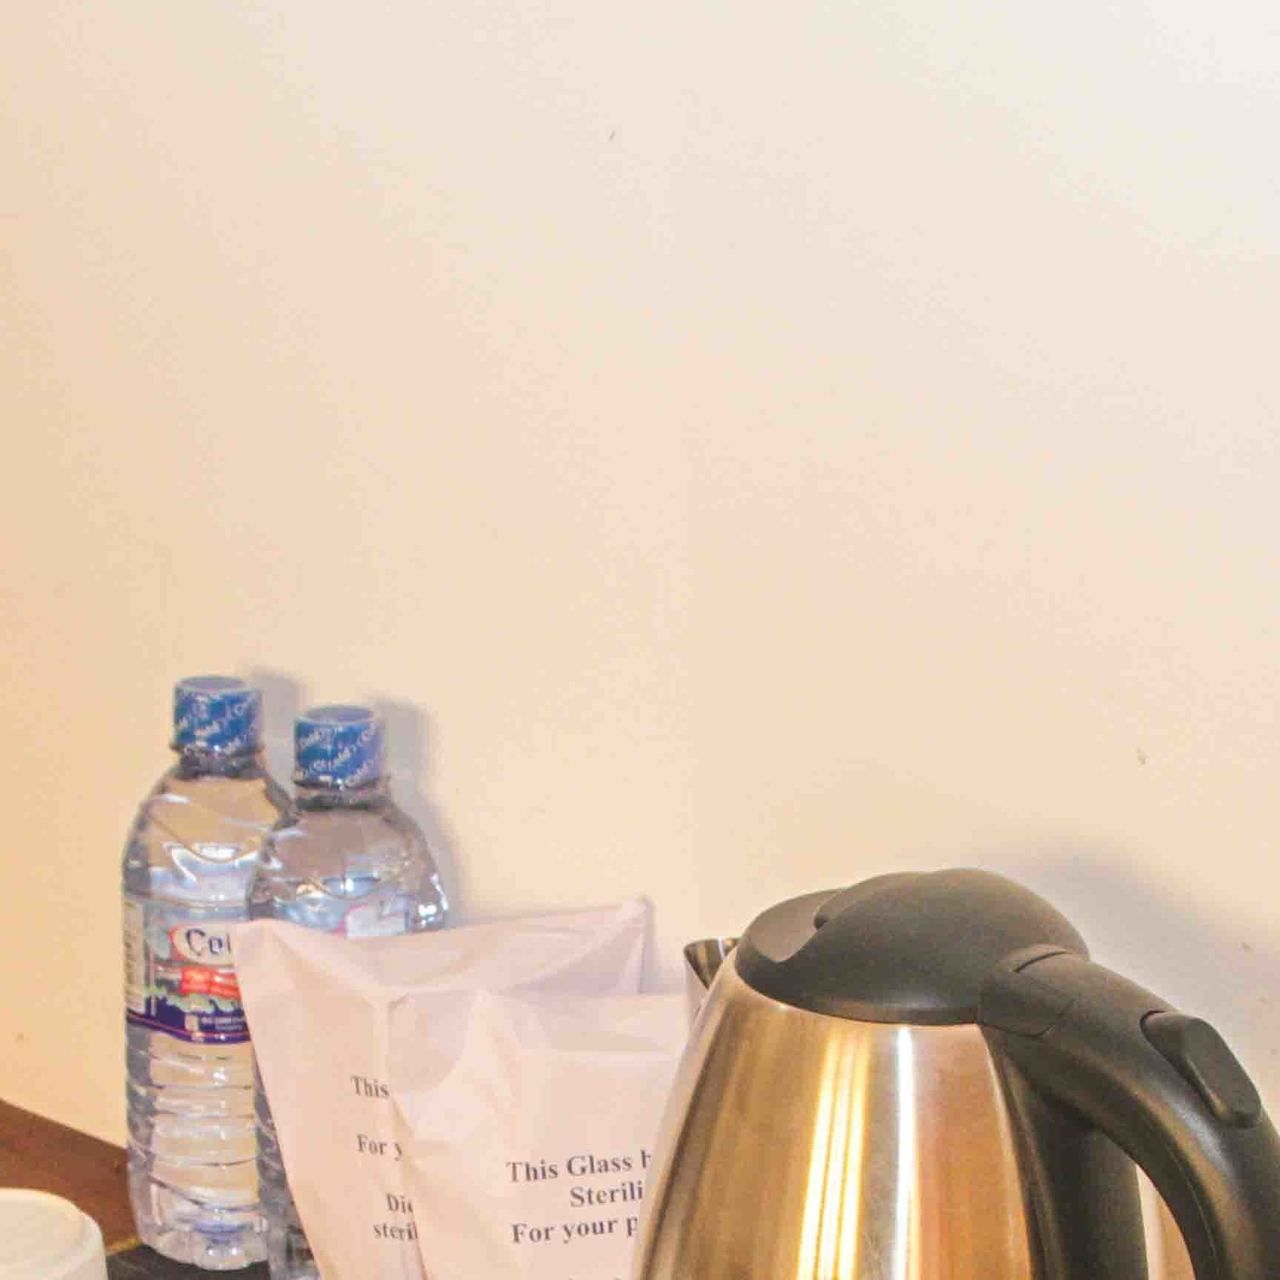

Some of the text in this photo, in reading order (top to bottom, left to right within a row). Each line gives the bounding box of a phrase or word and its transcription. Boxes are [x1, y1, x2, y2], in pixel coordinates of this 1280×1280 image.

[350, 1075, 390, 1099] This
[356, 1133, 387, 1154] For
[506, 1158, 559, 1182] This
[566, 1154, 632, 1177] Glass
[570, 1180, 644, 1208] Sterili
[373, 1221, 418, 1242] steril
[511, 1221, 554, 1244] For
[562, 1217, 619, 1244] your
